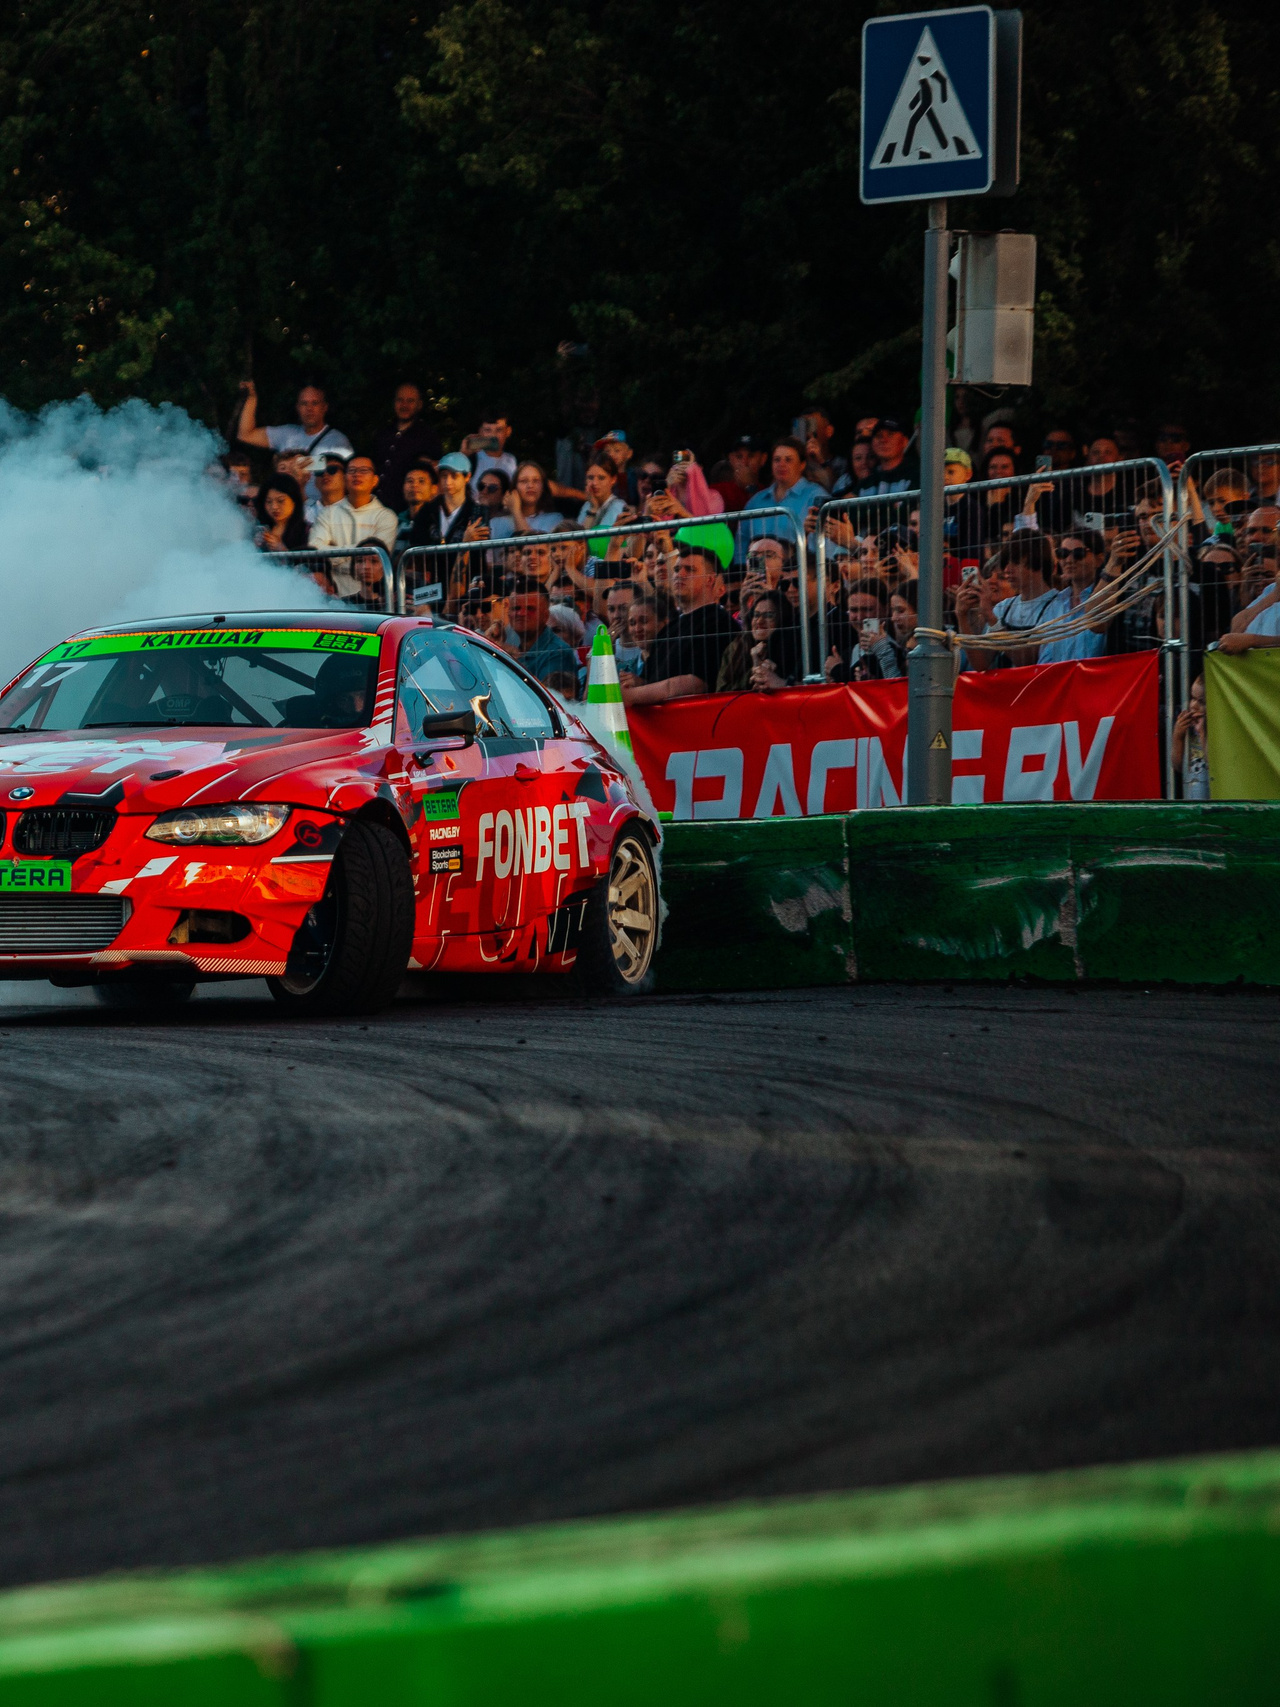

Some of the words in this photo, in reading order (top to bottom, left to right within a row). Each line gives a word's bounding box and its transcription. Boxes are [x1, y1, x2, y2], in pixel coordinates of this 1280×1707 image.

[60, 642, 93, 658] 17
[21, 661, 89, 689] 17
[476, 802, 591, 882] FONBET
[432, 860, 449, 871] Sports
